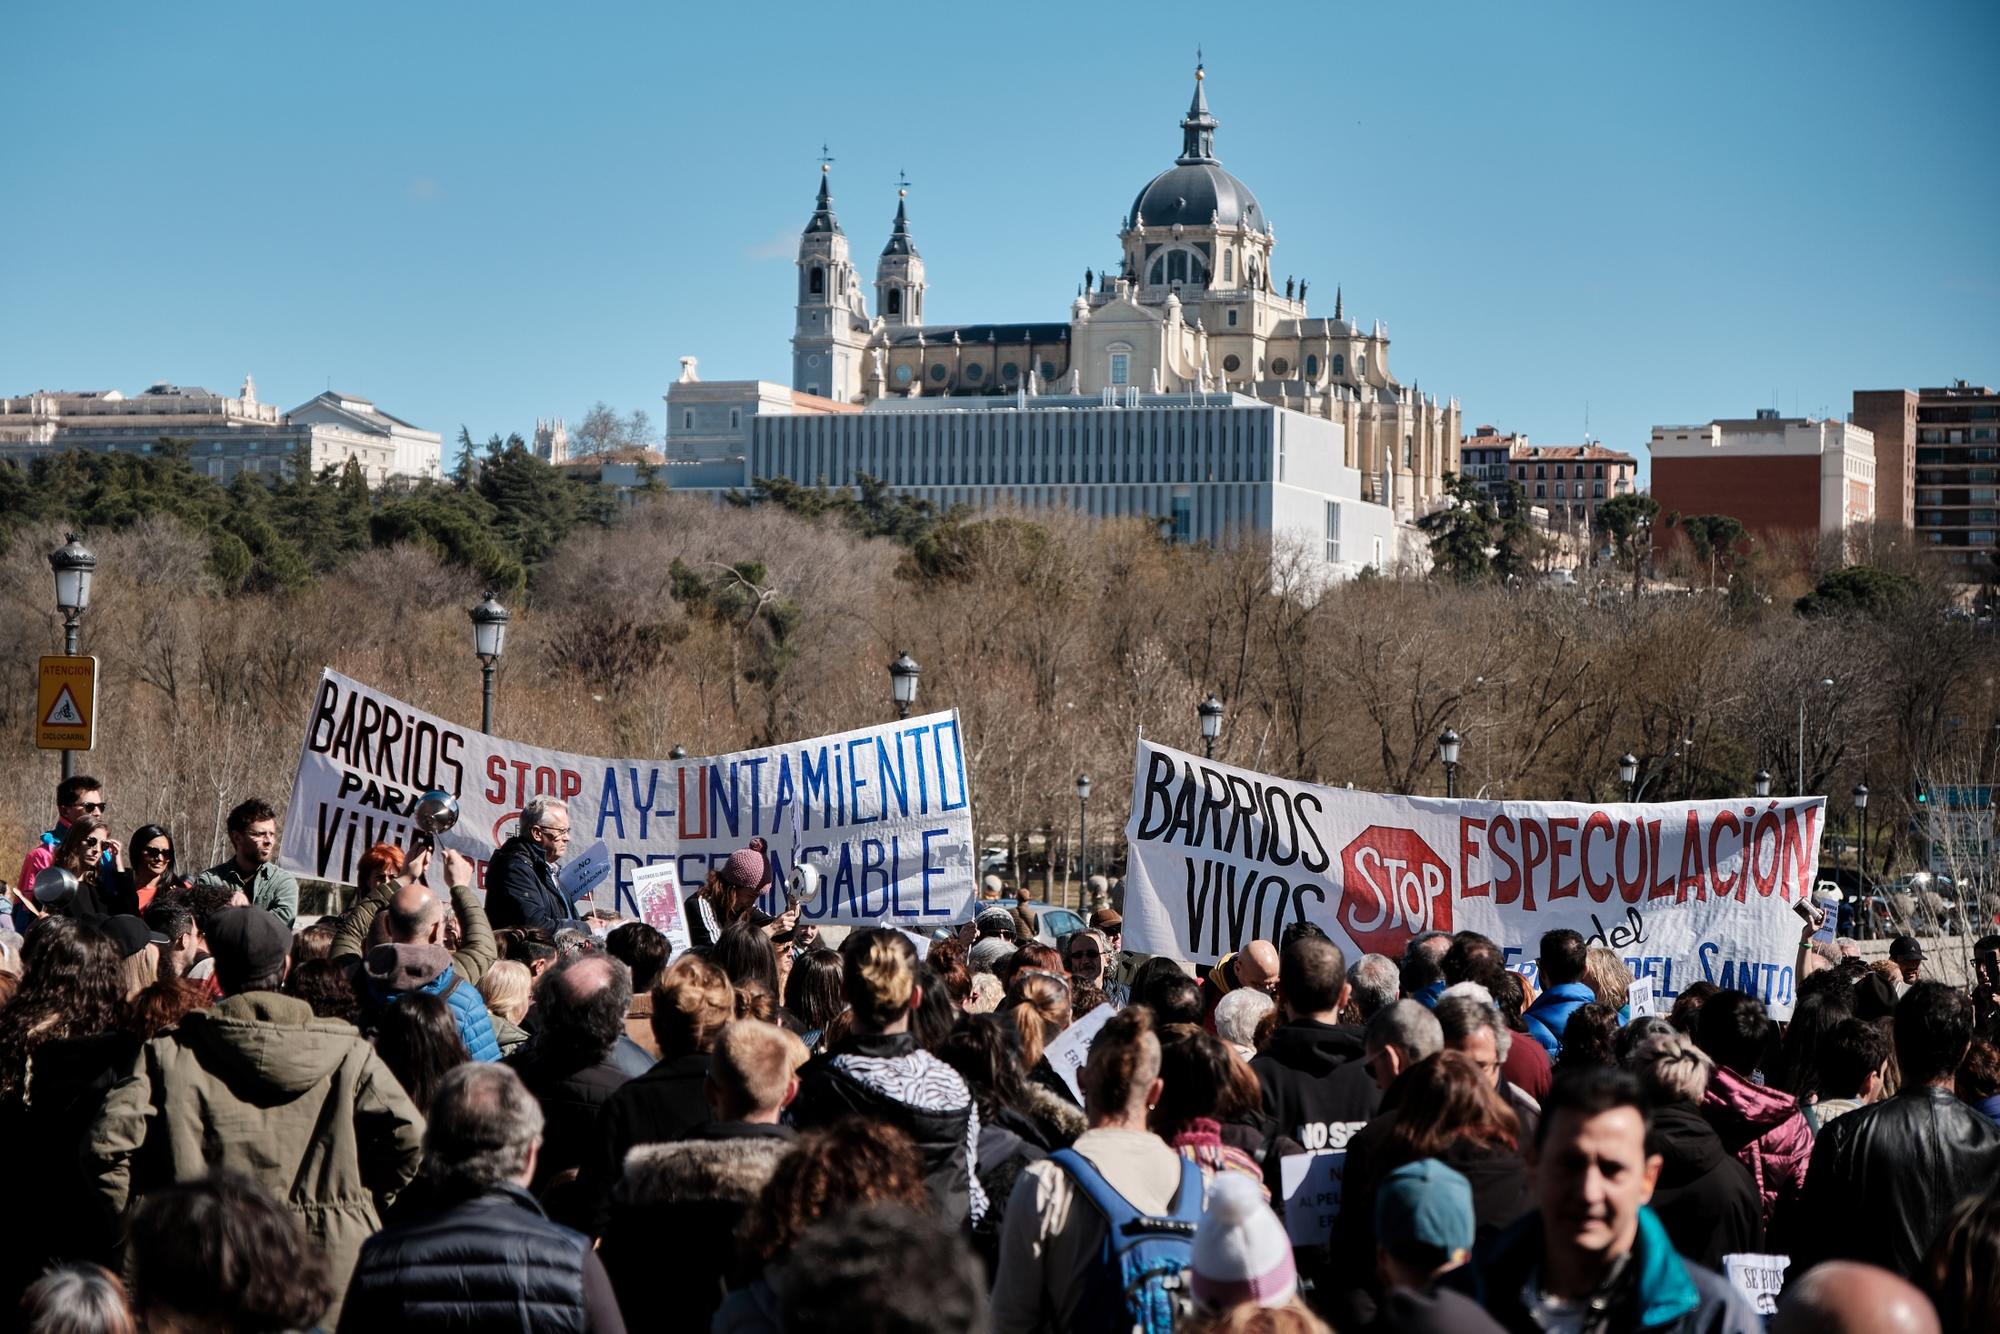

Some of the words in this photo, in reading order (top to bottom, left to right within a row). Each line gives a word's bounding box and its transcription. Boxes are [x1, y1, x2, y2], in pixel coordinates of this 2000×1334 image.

[43, 664, 91, 676] ATENCION
[485, 755, 582, 809] STOP
[1137, 751, 1330, 873] BARRIOS
[614, 829, 951, 919] RSNSABLE
[1347, 846, 1445, 935] STOP
[1586, 906, 1649, 949] del
[1624, 956, 1680, 998] DEL
[1298, 1121, 1328, 1150] NO
[1744, 1267, 1759, 1289] SE
